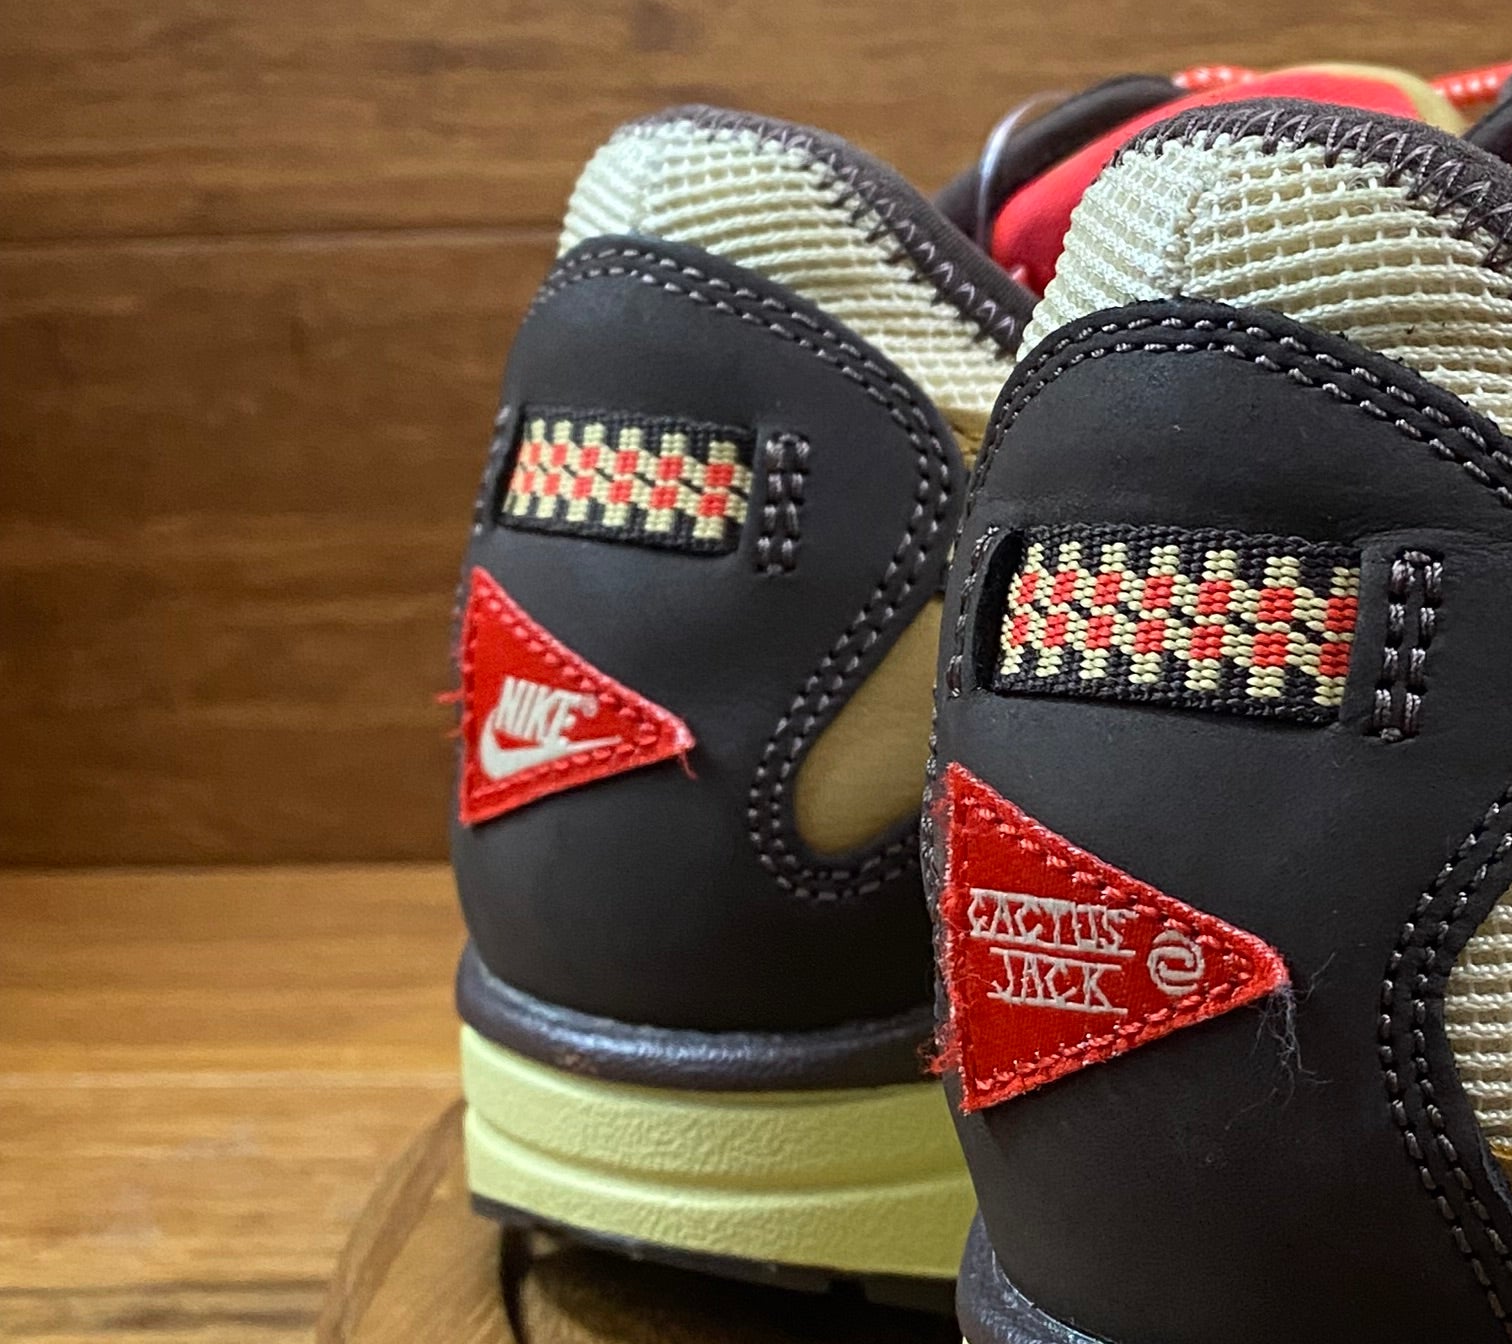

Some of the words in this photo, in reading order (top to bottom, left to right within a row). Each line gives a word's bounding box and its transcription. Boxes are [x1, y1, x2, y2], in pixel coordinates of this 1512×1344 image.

[493, 675, 584, 749] NIKE
[967, 887, 1138, 956] CACTUS
[987, 947, 1128, 1015] JACK
